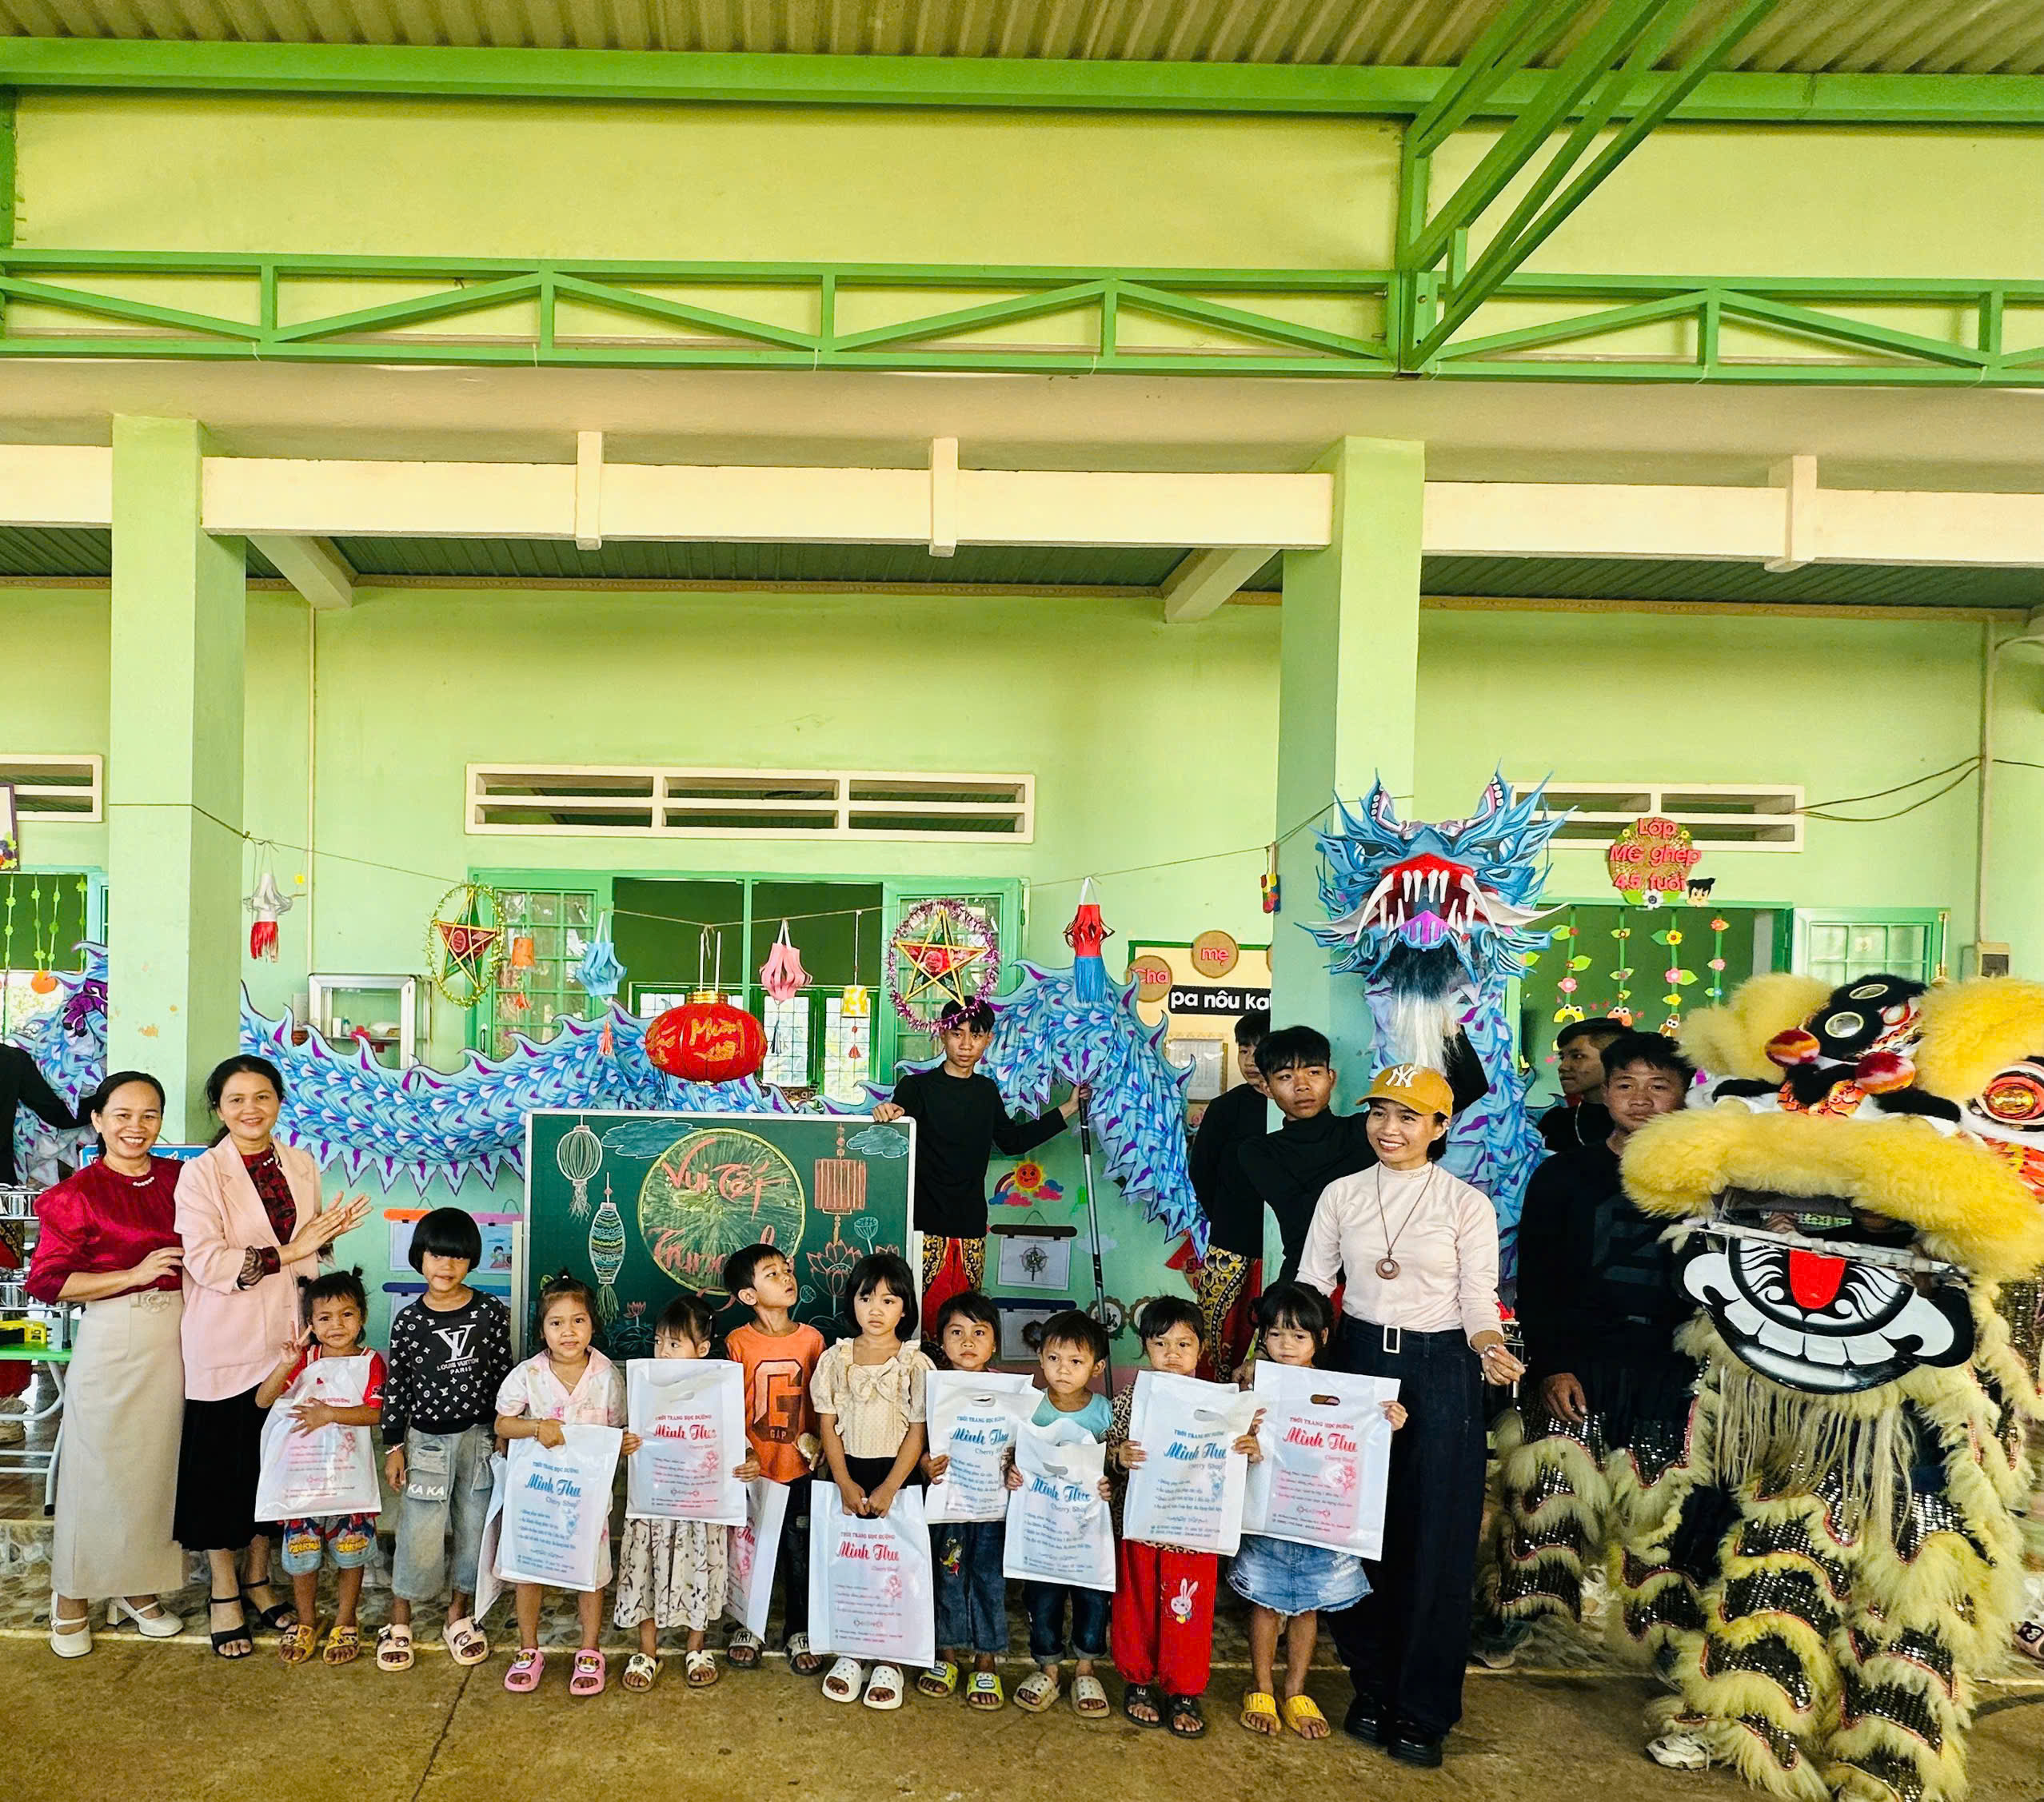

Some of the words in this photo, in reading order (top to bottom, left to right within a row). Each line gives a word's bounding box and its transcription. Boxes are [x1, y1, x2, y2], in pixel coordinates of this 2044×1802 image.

[1638, 817, 1677, 838] Lớp
[1610, 845, 1645, 863] MG
[1201, 947, 1229, 966] mẹ
[1171, 991, 1199, 1009] pa
[1204, 990, 1240, 1009] nôu
[1245, 993, 1271, 1011] ka
[661, 1138, 717, 1193] Vui
[449, 1365, 473, 1375] PARIS
[769, 1429, 787, 1440] GAP
[408, 1484, 423, 1495] KA
[426, 1485, 444, 1497] KA
